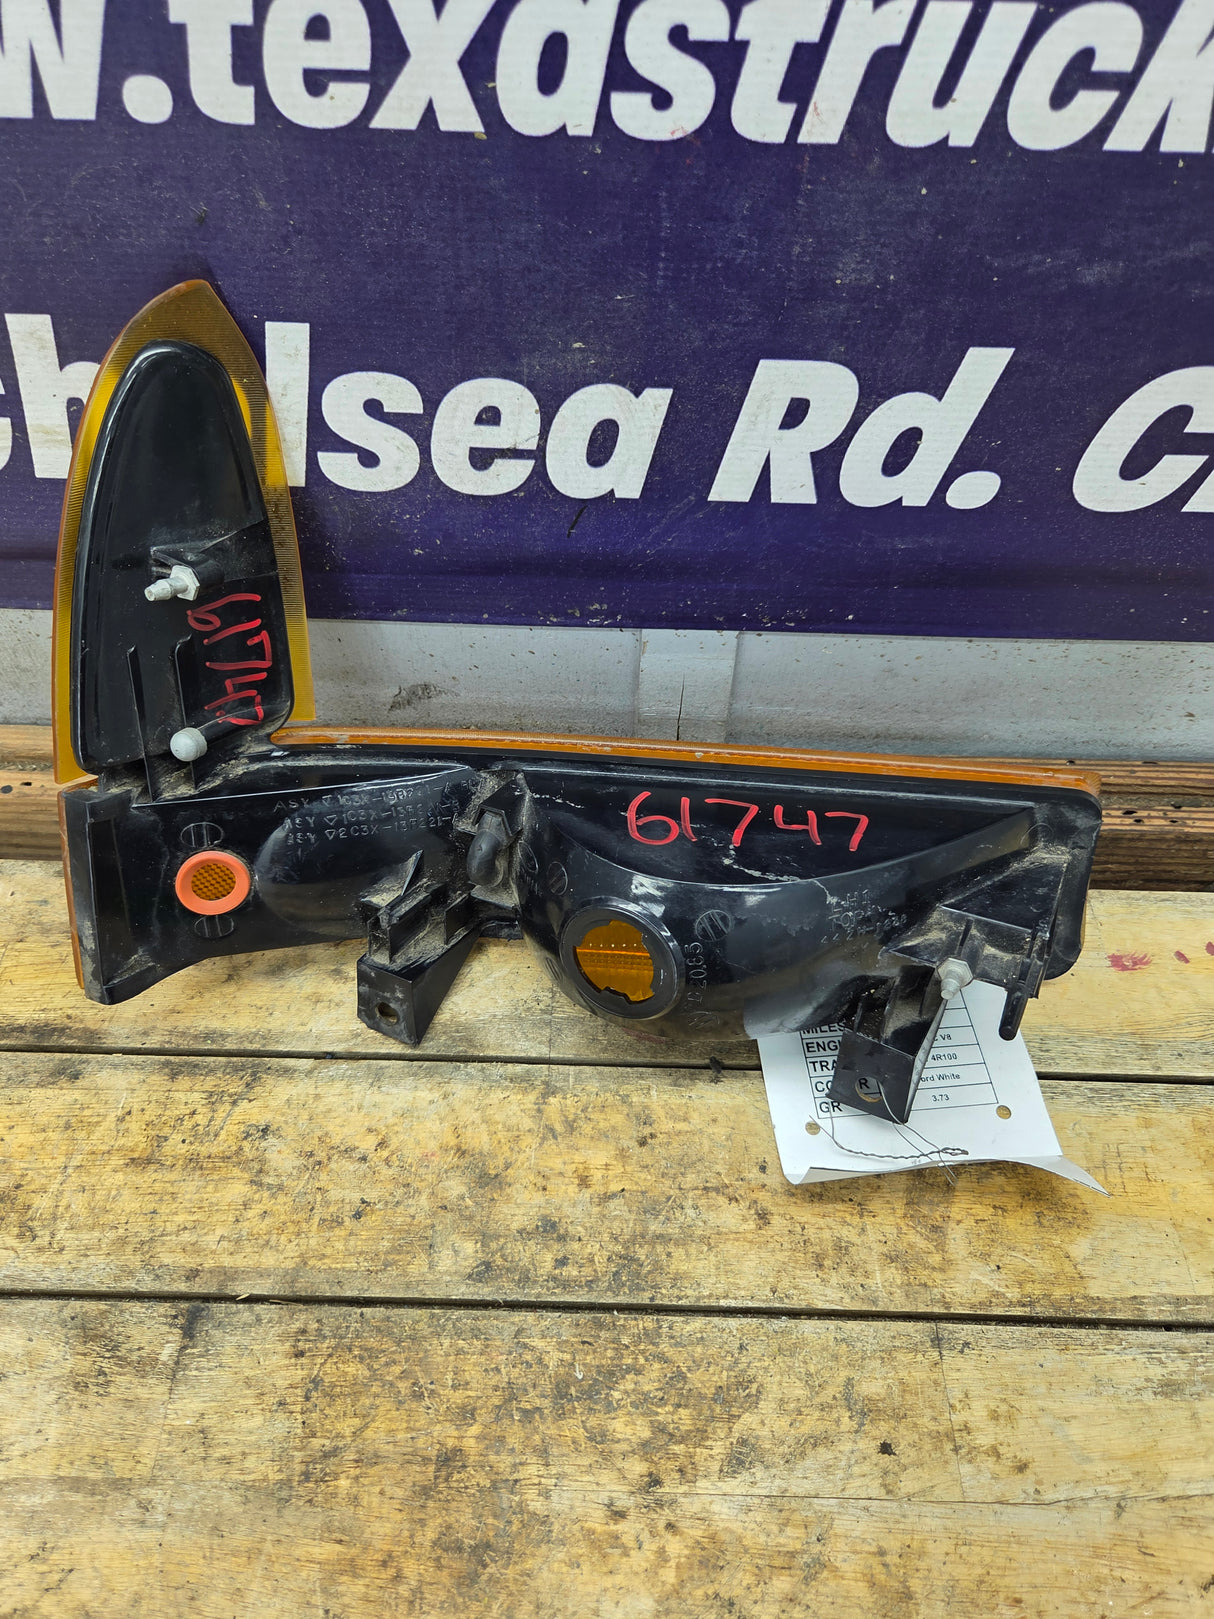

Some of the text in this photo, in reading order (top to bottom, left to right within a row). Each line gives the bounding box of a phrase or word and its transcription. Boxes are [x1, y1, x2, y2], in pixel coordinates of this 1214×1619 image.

[708, 347, 1001, 509] Rd.
[1072, 365, 1214, 513] C
[627, 791, 869, 852] 61747
[940, 1033, 952, 1041] V8
[931, 1052, 958, 1061] 4R100
[936, 1073, 961, 1081] White
[932, 1093, 950, 1102] 3.73
